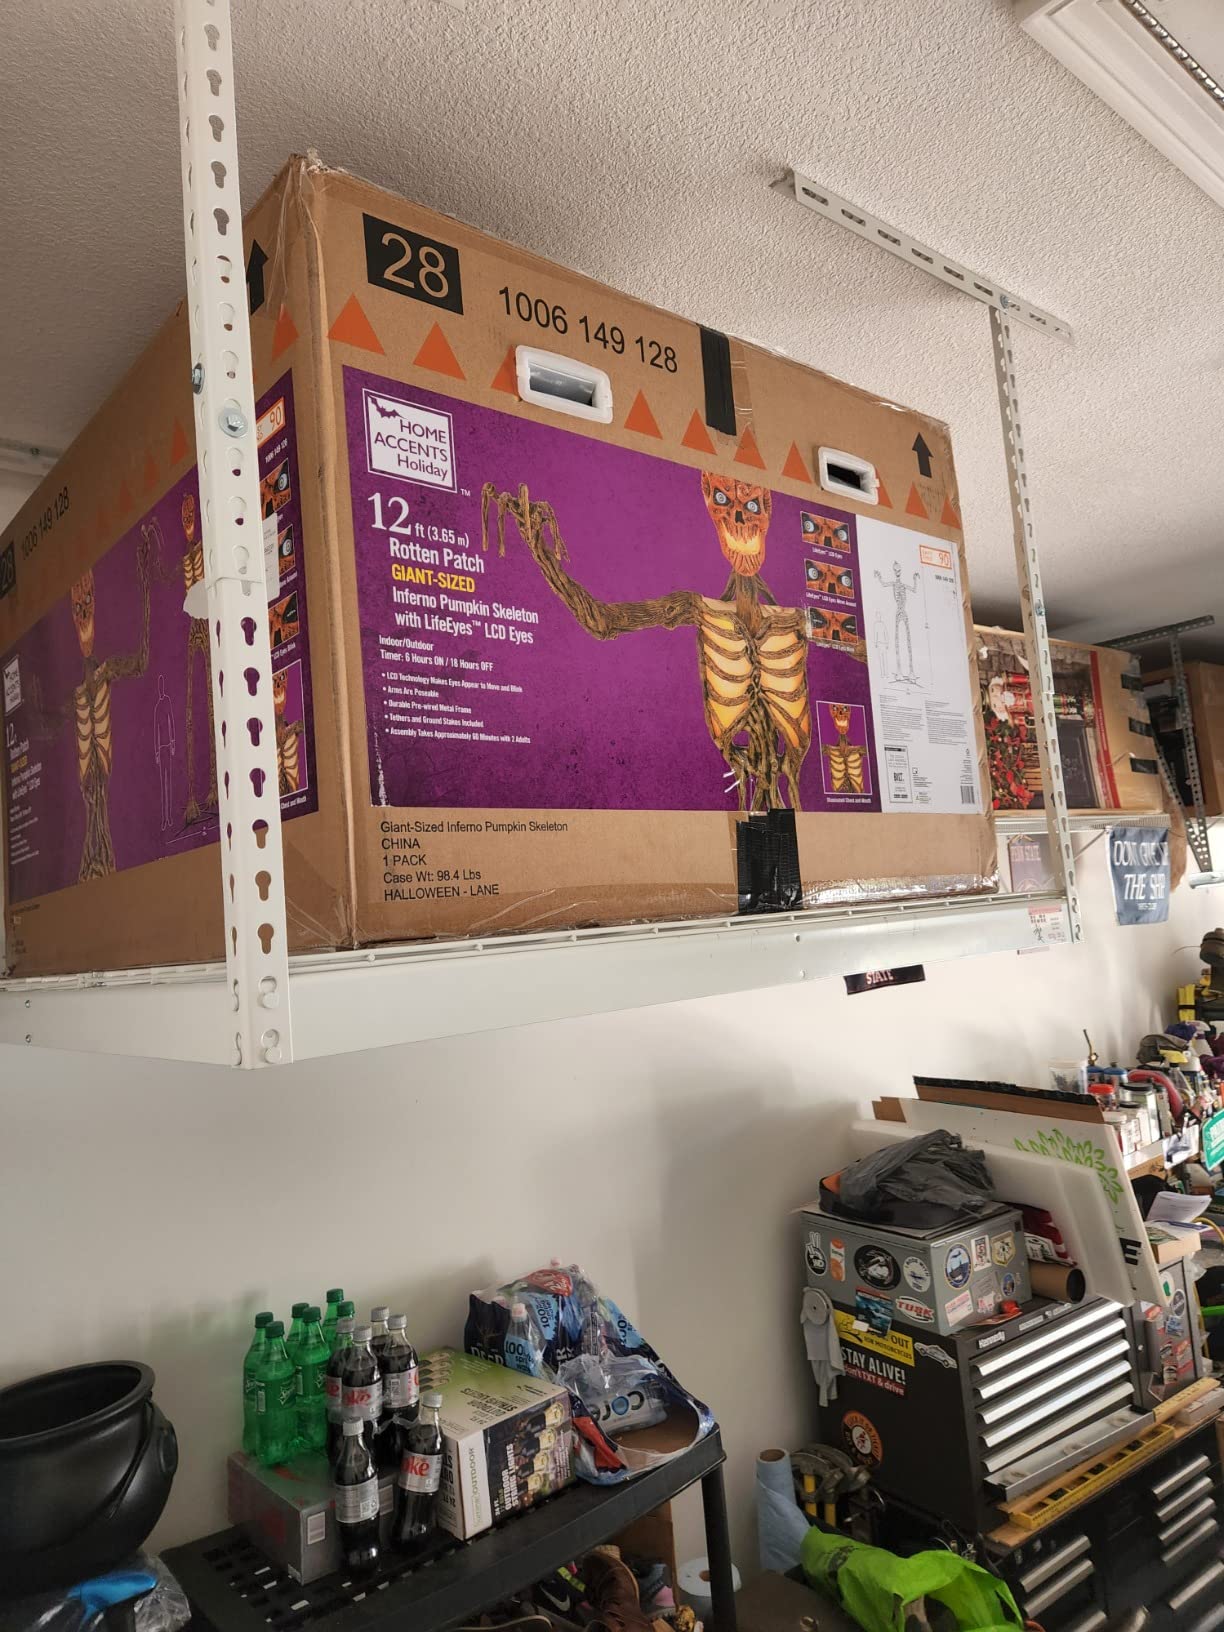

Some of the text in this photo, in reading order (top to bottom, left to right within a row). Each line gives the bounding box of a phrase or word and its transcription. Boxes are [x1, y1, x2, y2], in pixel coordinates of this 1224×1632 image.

[381, 231, 449, 298] 28
[499, 286, 678, 373] 1006 149 128
[269, 405, 282, 431] 90
[400, 418, 447, 444] HOME
[374, 432, 448, 462] ACCENTS
[396, 454, 448, 480] Holiday
[367, 492, 470, 549] 12 ft (3.65 m)
[389, 537, 485, 574] Rotten Patch
[391, 564, 475, 593] GIANT-SIZED
[393, 586, 539, 625] Inferno Pumpkin Skeleton
[395, 611, 422, 629] with
[484, 622, 506, 639] LCD
[509, 627, 534, 645] Eyes
[379, 635, 434, 651] Indoor/Outdoor
[380, 649, 404, 662] Timer:
[404, 652, 410, 662] 6
[412, 654, 433, 666] Hours
[434, 656, 444, 666] ON
[450, 658, 458, 668] 18
[460, 659, 480, 670] Hours
[481, 661, 494, 672] OFF
[387, 672, 398, 681] LCD
[399, 673, 430, 685] Technology
[430, 676, 448, 686] Makes
[448, 678, 461, 688] Eyes
[462, 680, 480, 690] Appear
[480, 682, 486, 690] to
[501, 684, 510, 692] and
[388, 686, 440, 698] Arms Are Poseable
[388, 700, 472, 714] Durable Pre-wired Metal Frame
[390, 713, 485, 728] Tethers and Ground Stakes Included
[390, 727, 418, 738] Assembly
[418, 728, 434, 738] Takes
[434, 730, 472, 742] Approximately
[480, 734, 500, 742] Minutes
[500, 735, 512, 743] with
[516, 736, 531, 744] Adults
[380, 820, 568, 834] Giant-Sized Inferno Pumpkin Skeleton
[382, 838, 420, 850] CHINA
[383, 854, 427, 867] 1 PACK
[383, 869, 482, 884] Case Wt: 98.4 Lbs
[1124, 873, 1146, 900] THE
[384, 886, 460, 901] HALLOWEEN
[470, 884, 500, 896] LANE
[866, 968, 894, 985] STATE
[890, 1335, 909, 1349] OUT
[840, 1346, 906, 1385] STAY ALIVE!
[506, 1443, 519, 1507] STRING LIGHTS
[502, 1468, 512, 1510] OUTDOOR
